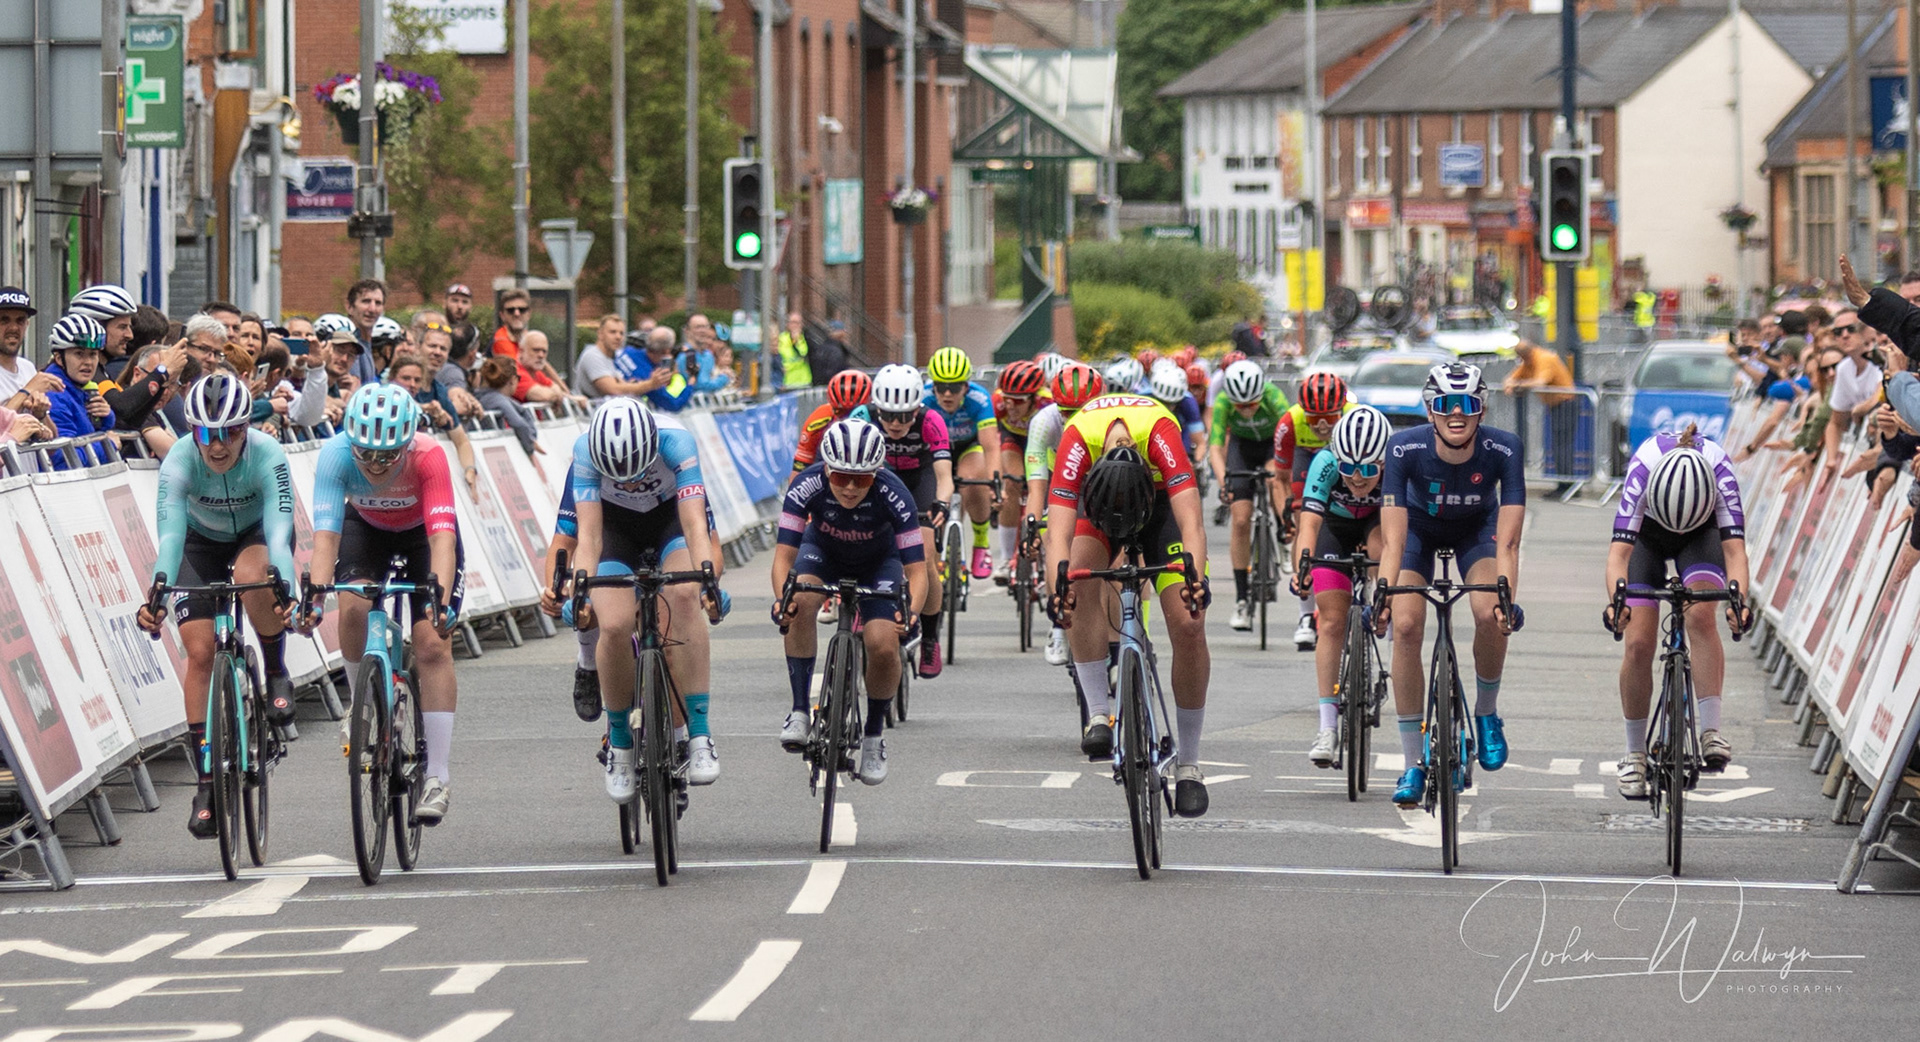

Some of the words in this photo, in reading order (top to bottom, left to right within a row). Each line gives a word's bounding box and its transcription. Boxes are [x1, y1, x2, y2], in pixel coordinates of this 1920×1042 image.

[391, 7, 498, 20] rrisons
[132, 28, 166, 44] night
[1085, 397, 1157, 411] CAMS
[884, 442, 922, 453] other
[1062, 442, 1087, 481] CAMS
[199, 492, 258, 503] Bianchi
[787, 474, 823, 508] Plantur
[359, 498, 374, 507] LE
[879, 484, 912, 523] PURA
[820, 521, 875, 541] Plantur
